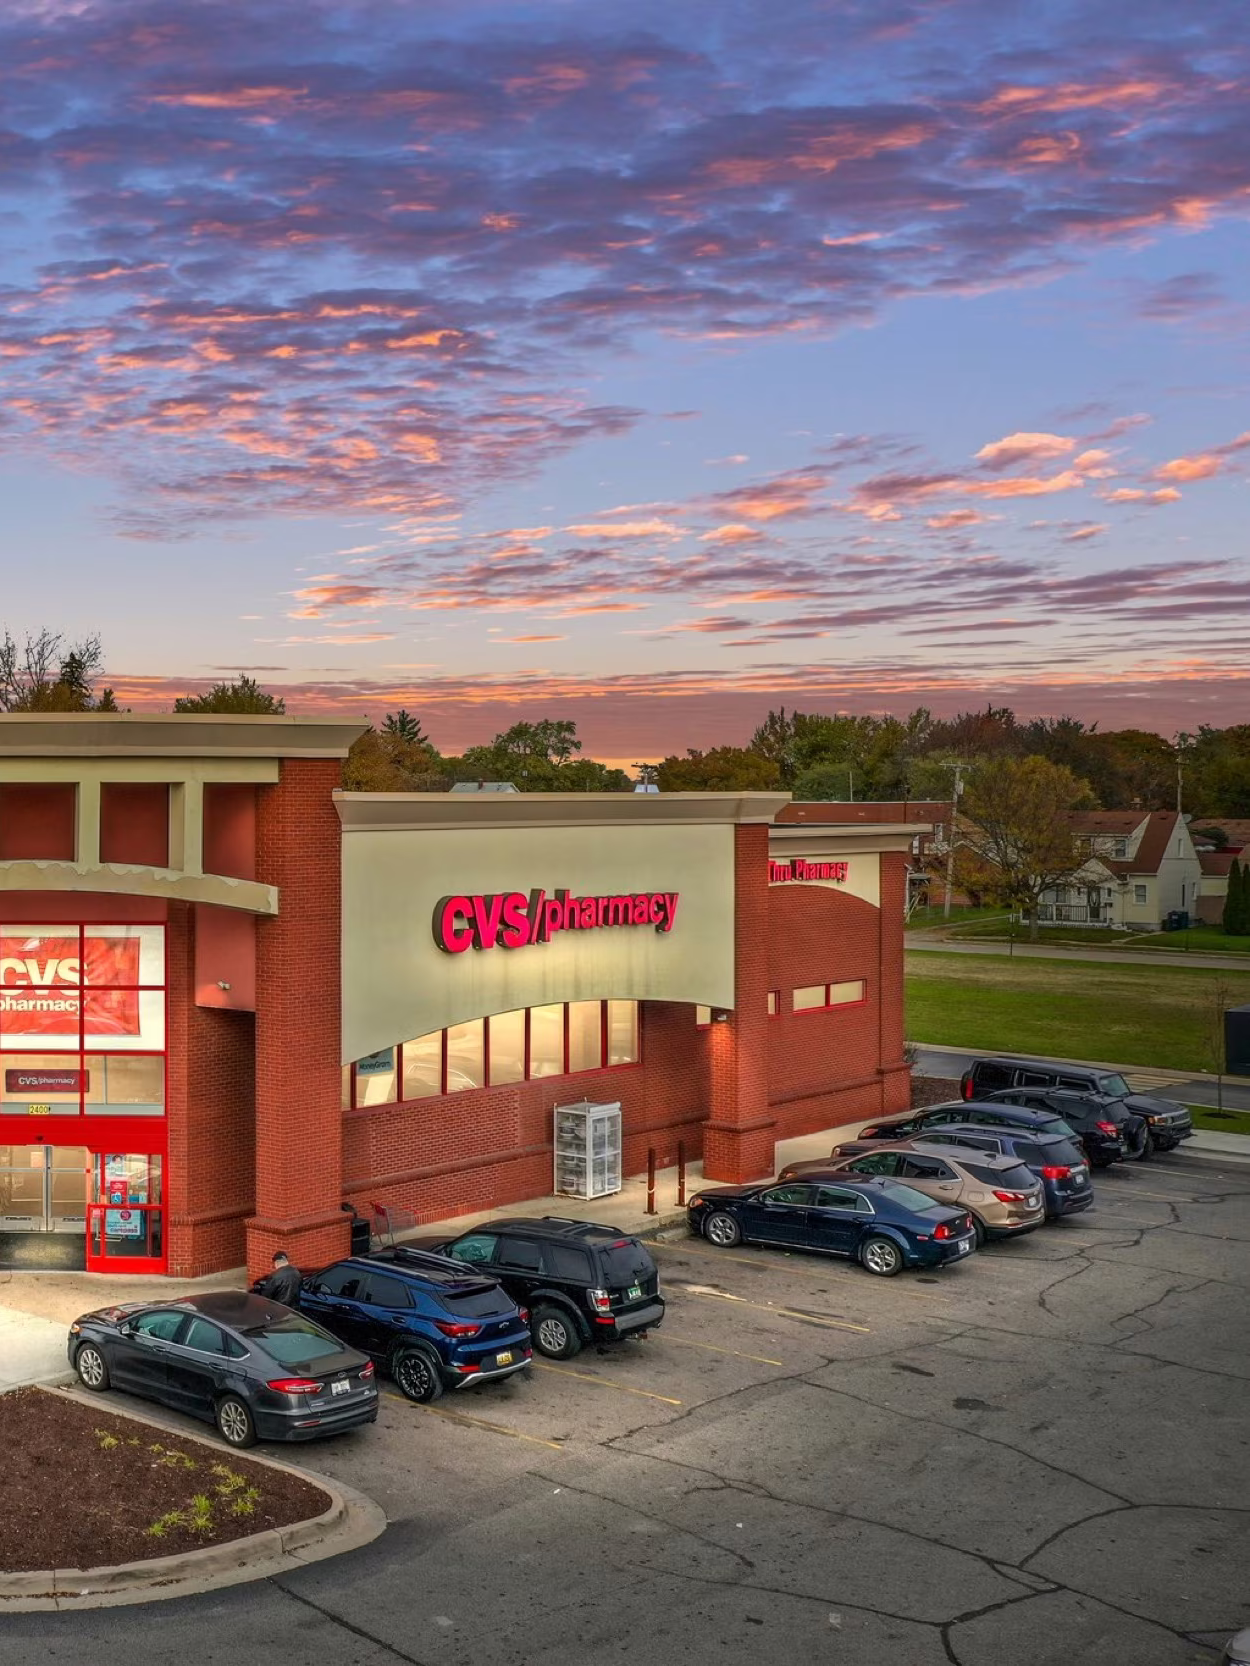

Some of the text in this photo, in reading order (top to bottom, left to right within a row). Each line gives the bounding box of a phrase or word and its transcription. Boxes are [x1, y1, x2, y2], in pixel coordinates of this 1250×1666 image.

[796, 859, 849, 883] Pharmacy
[433, 889, 679, 953] CVS/pharmacy
[18, 1076, 76, 1086] CVS/pharmacy
[30, 1105, 48, 1114] 2400
